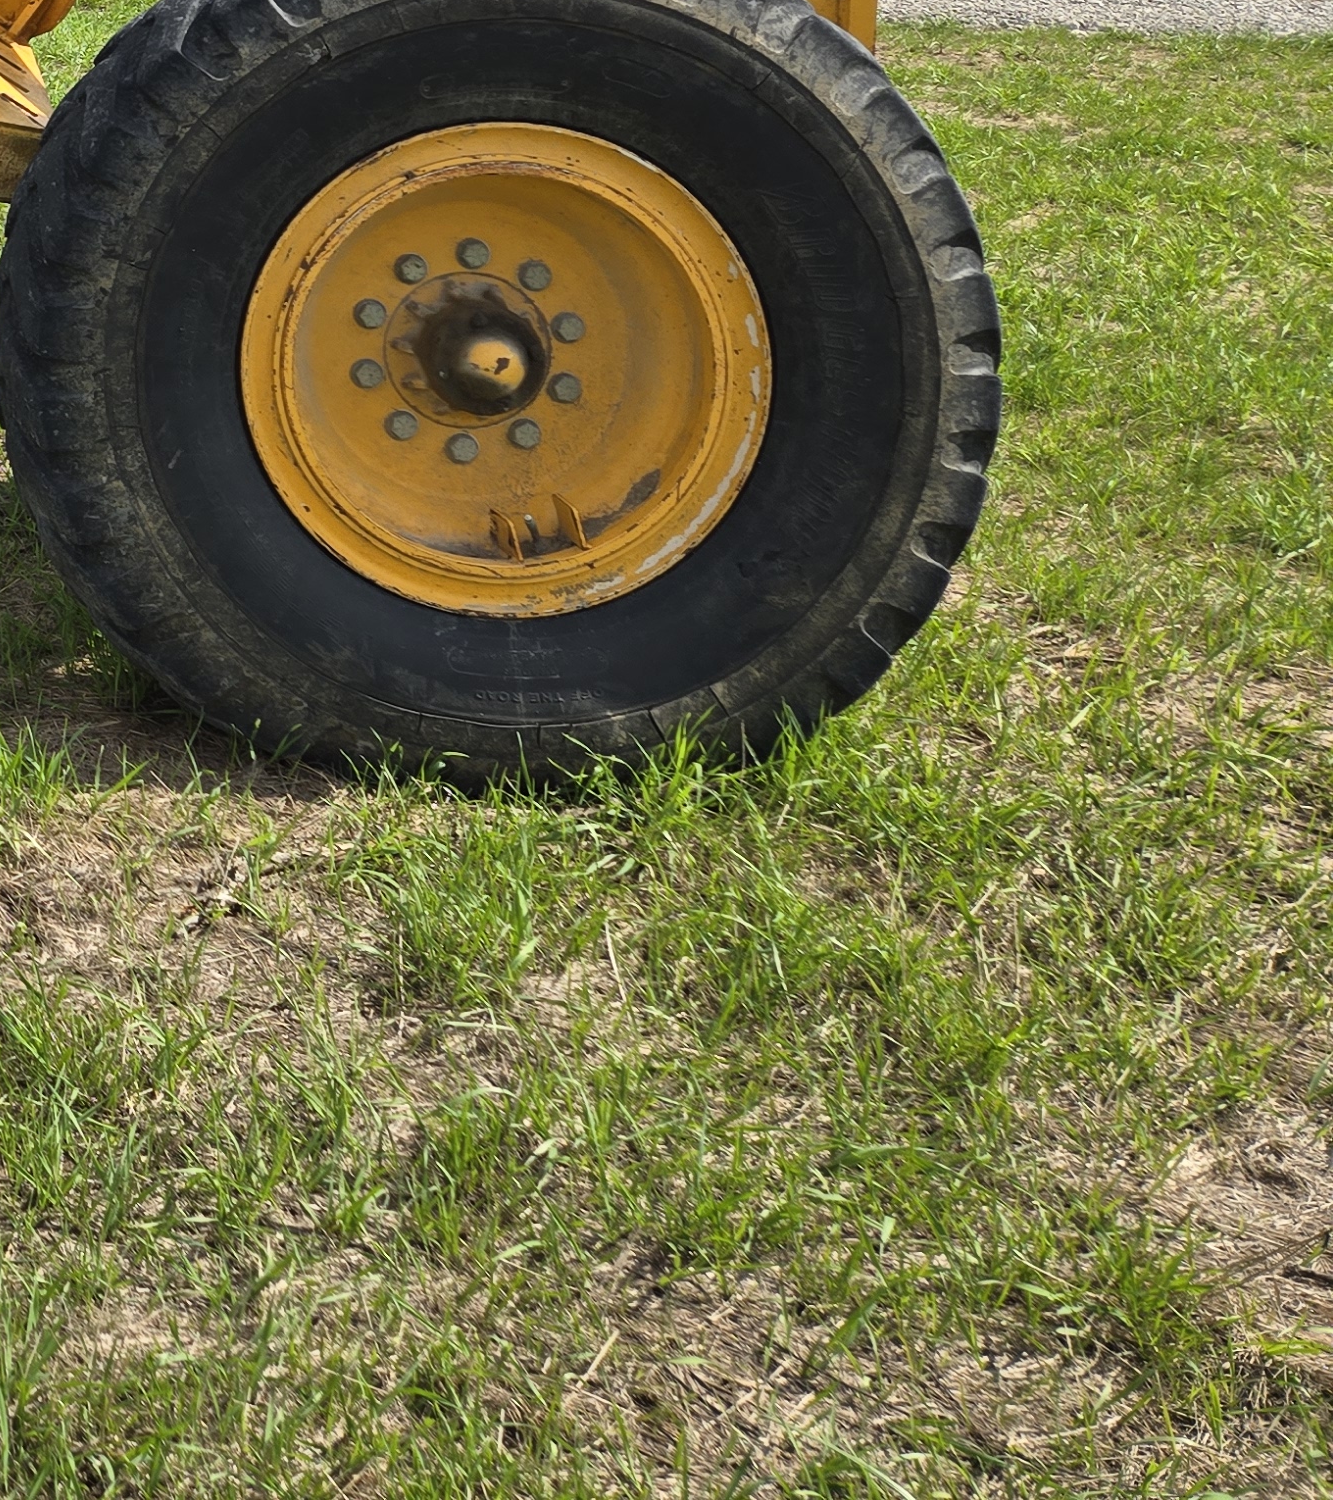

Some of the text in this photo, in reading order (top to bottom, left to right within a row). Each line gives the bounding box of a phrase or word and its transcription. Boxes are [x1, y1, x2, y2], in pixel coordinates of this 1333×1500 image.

[476, 688, 604, 703] OFF THE ROAD
